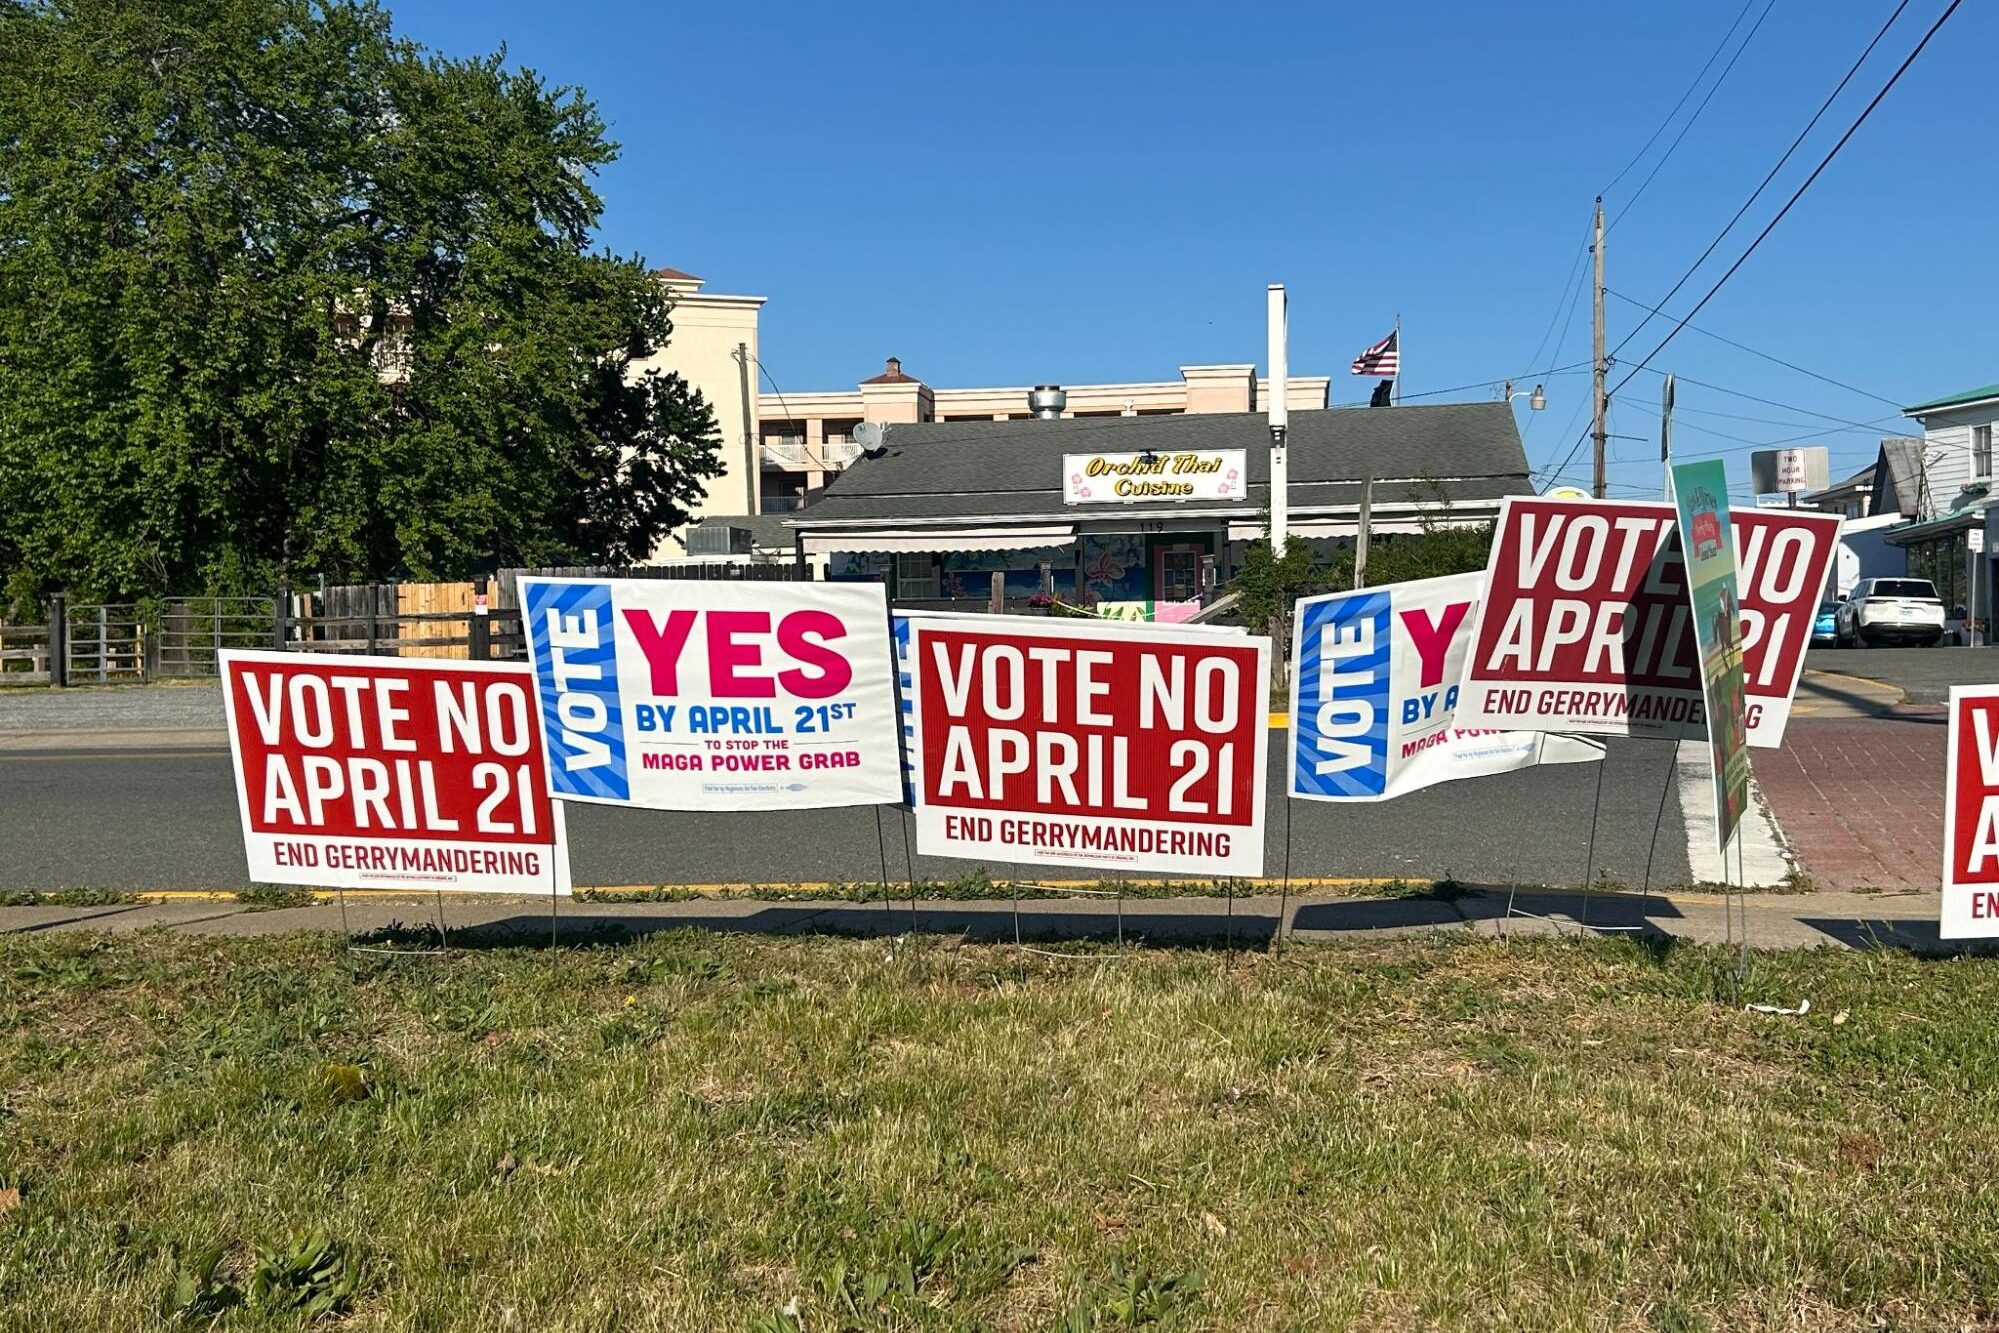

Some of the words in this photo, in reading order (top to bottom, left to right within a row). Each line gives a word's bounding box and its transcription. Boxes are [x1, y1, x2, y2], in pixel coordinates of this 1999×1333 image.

[1085, 454, 1169, 477] Orchid
[1171, 453, 1222, 474] Thai
[1784, 455, 1797, 463] TWO
[1114, 478, 1193, 496] Cuisine
[1778, 477, 1805, 485] PARKING
[1140, 521, 1163, 532] 119
[1517, 512, 1681, 595] VOTE
[621, 609, 853, 699] YES
[1485, 598, 1693, 678] APRIL
[545, 607, 612, 772] VOTE
[931, 641, 1114, 727] VOTE
[1139, 653, 1240, 734] NO
[1315, 617, 1375, 775] VOTE
[241, 671, 417, 752] VOTE
[433, 680, 531, 757] NO
[635, 704, 677, 732] BY
[688, 705, 784, 734] APRIL
[795, 703, 857, 734] 21ST
[1402, 691, 1438, 725] BY
[1483, 688, 1532, 715] END
[1537, 690, 1763, 730] GERRYMANDEG
[642, 752, 701, 771] MAGA
[711, 755, 791, 772] POWER
[799, 751, 861, 771] GRAB
[704, 740, 722, 750] TO
[726, 740, 759, 750] STOP
[763, 739, 789, 750] THE
[1402, 729, 1449, 759] MAGA
[938, 725, 1148, 810] APRIL
[1168, 739, 1234, 815] 21
[263, 753, 459, 832] APRIL
[471, 762, 537, 835] 21
[945, 814, 993, 843] END
[1000, 818, 1231, 858] GERRYMANDERING
[273, 841, 319, 867] END
[326, 844, 540, 876] GERRYMANDERING
[1972, 892, 1999, 918] EN
